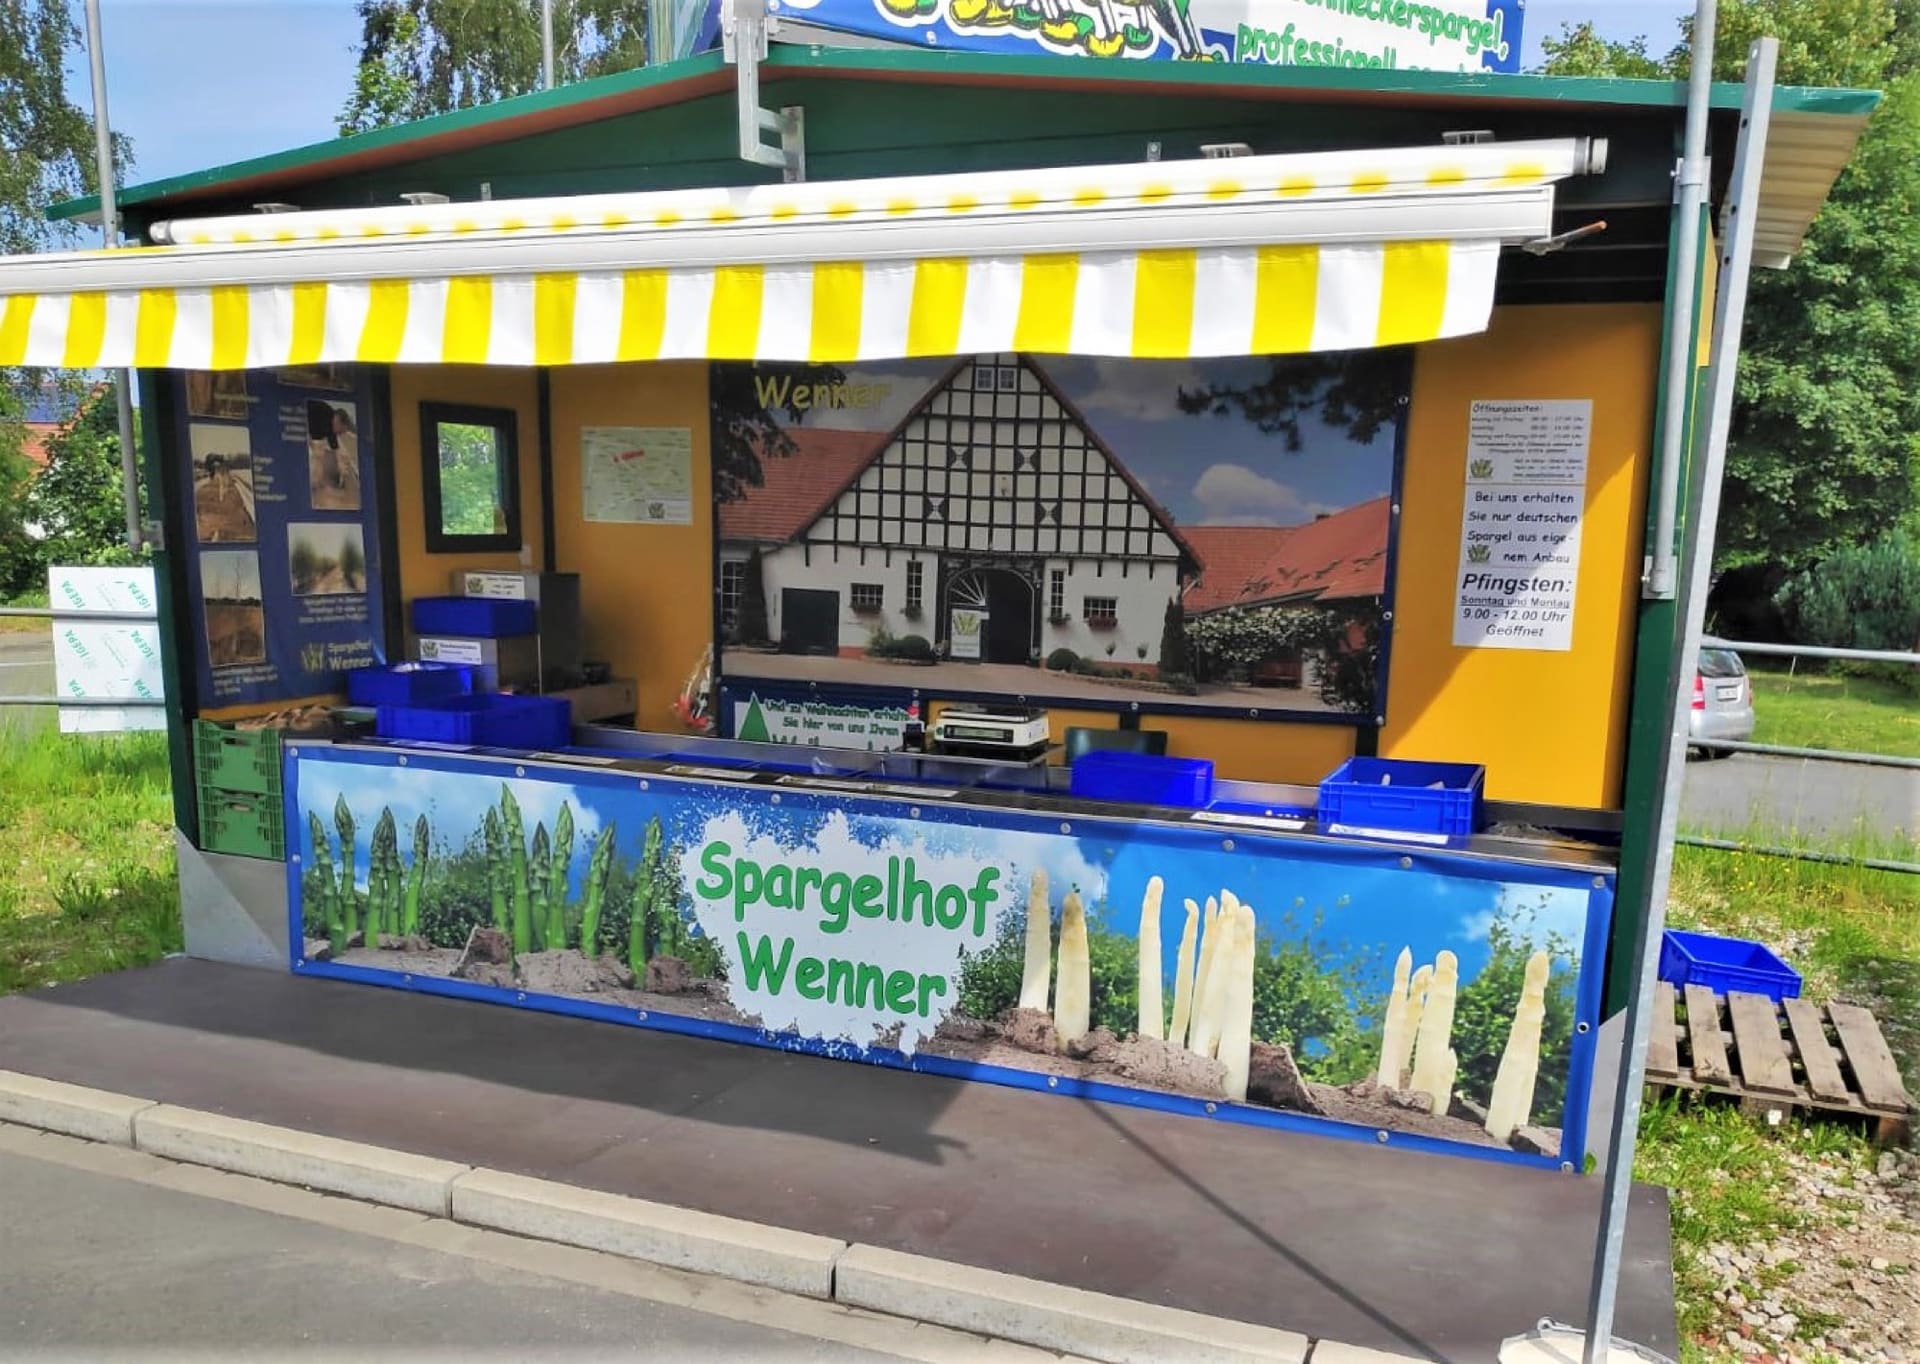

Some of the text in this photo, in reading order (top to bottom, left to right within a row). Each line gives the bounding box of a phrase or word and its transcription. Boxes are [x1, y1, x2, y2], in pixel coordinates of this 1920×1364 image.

[754, 375, 893, 409] Wenner
[1475, 491, 1574, 503] Bei uns erhalten
[1468, 511, 1578, 523] Sie nur deutschen
[1467, 529, 1512, 544] Spargel
[1517, 533, 1537, 542] aus
[1503, 552, 1570, 563] nem Anbau
[1462, 573, 1572, 595] Pfingsten:
[62, 580, 86, 609] IGEPA
[128, 581, 151, 609] IGEPA
[1461, 595, 1569, 608] Sonntag und Montag
[1503, 609, 1538, 621] 12.00
[1542, 610, 1568, 622] Uhr
[1485, 624, 1544, 637] Geöffnet
[65, 629, 89, 658] IGEPA
[131, 630, 154, 658] IGEPA
[765, 699, 785, 712] Und
[804, 703, 870, 718] Weihnachten
[782, 716, 899, 736] Sie hier von uns Ihren
[695, 840, 1000, 937] Spargelhof
[736, 930, 948, 1018] Wenner
